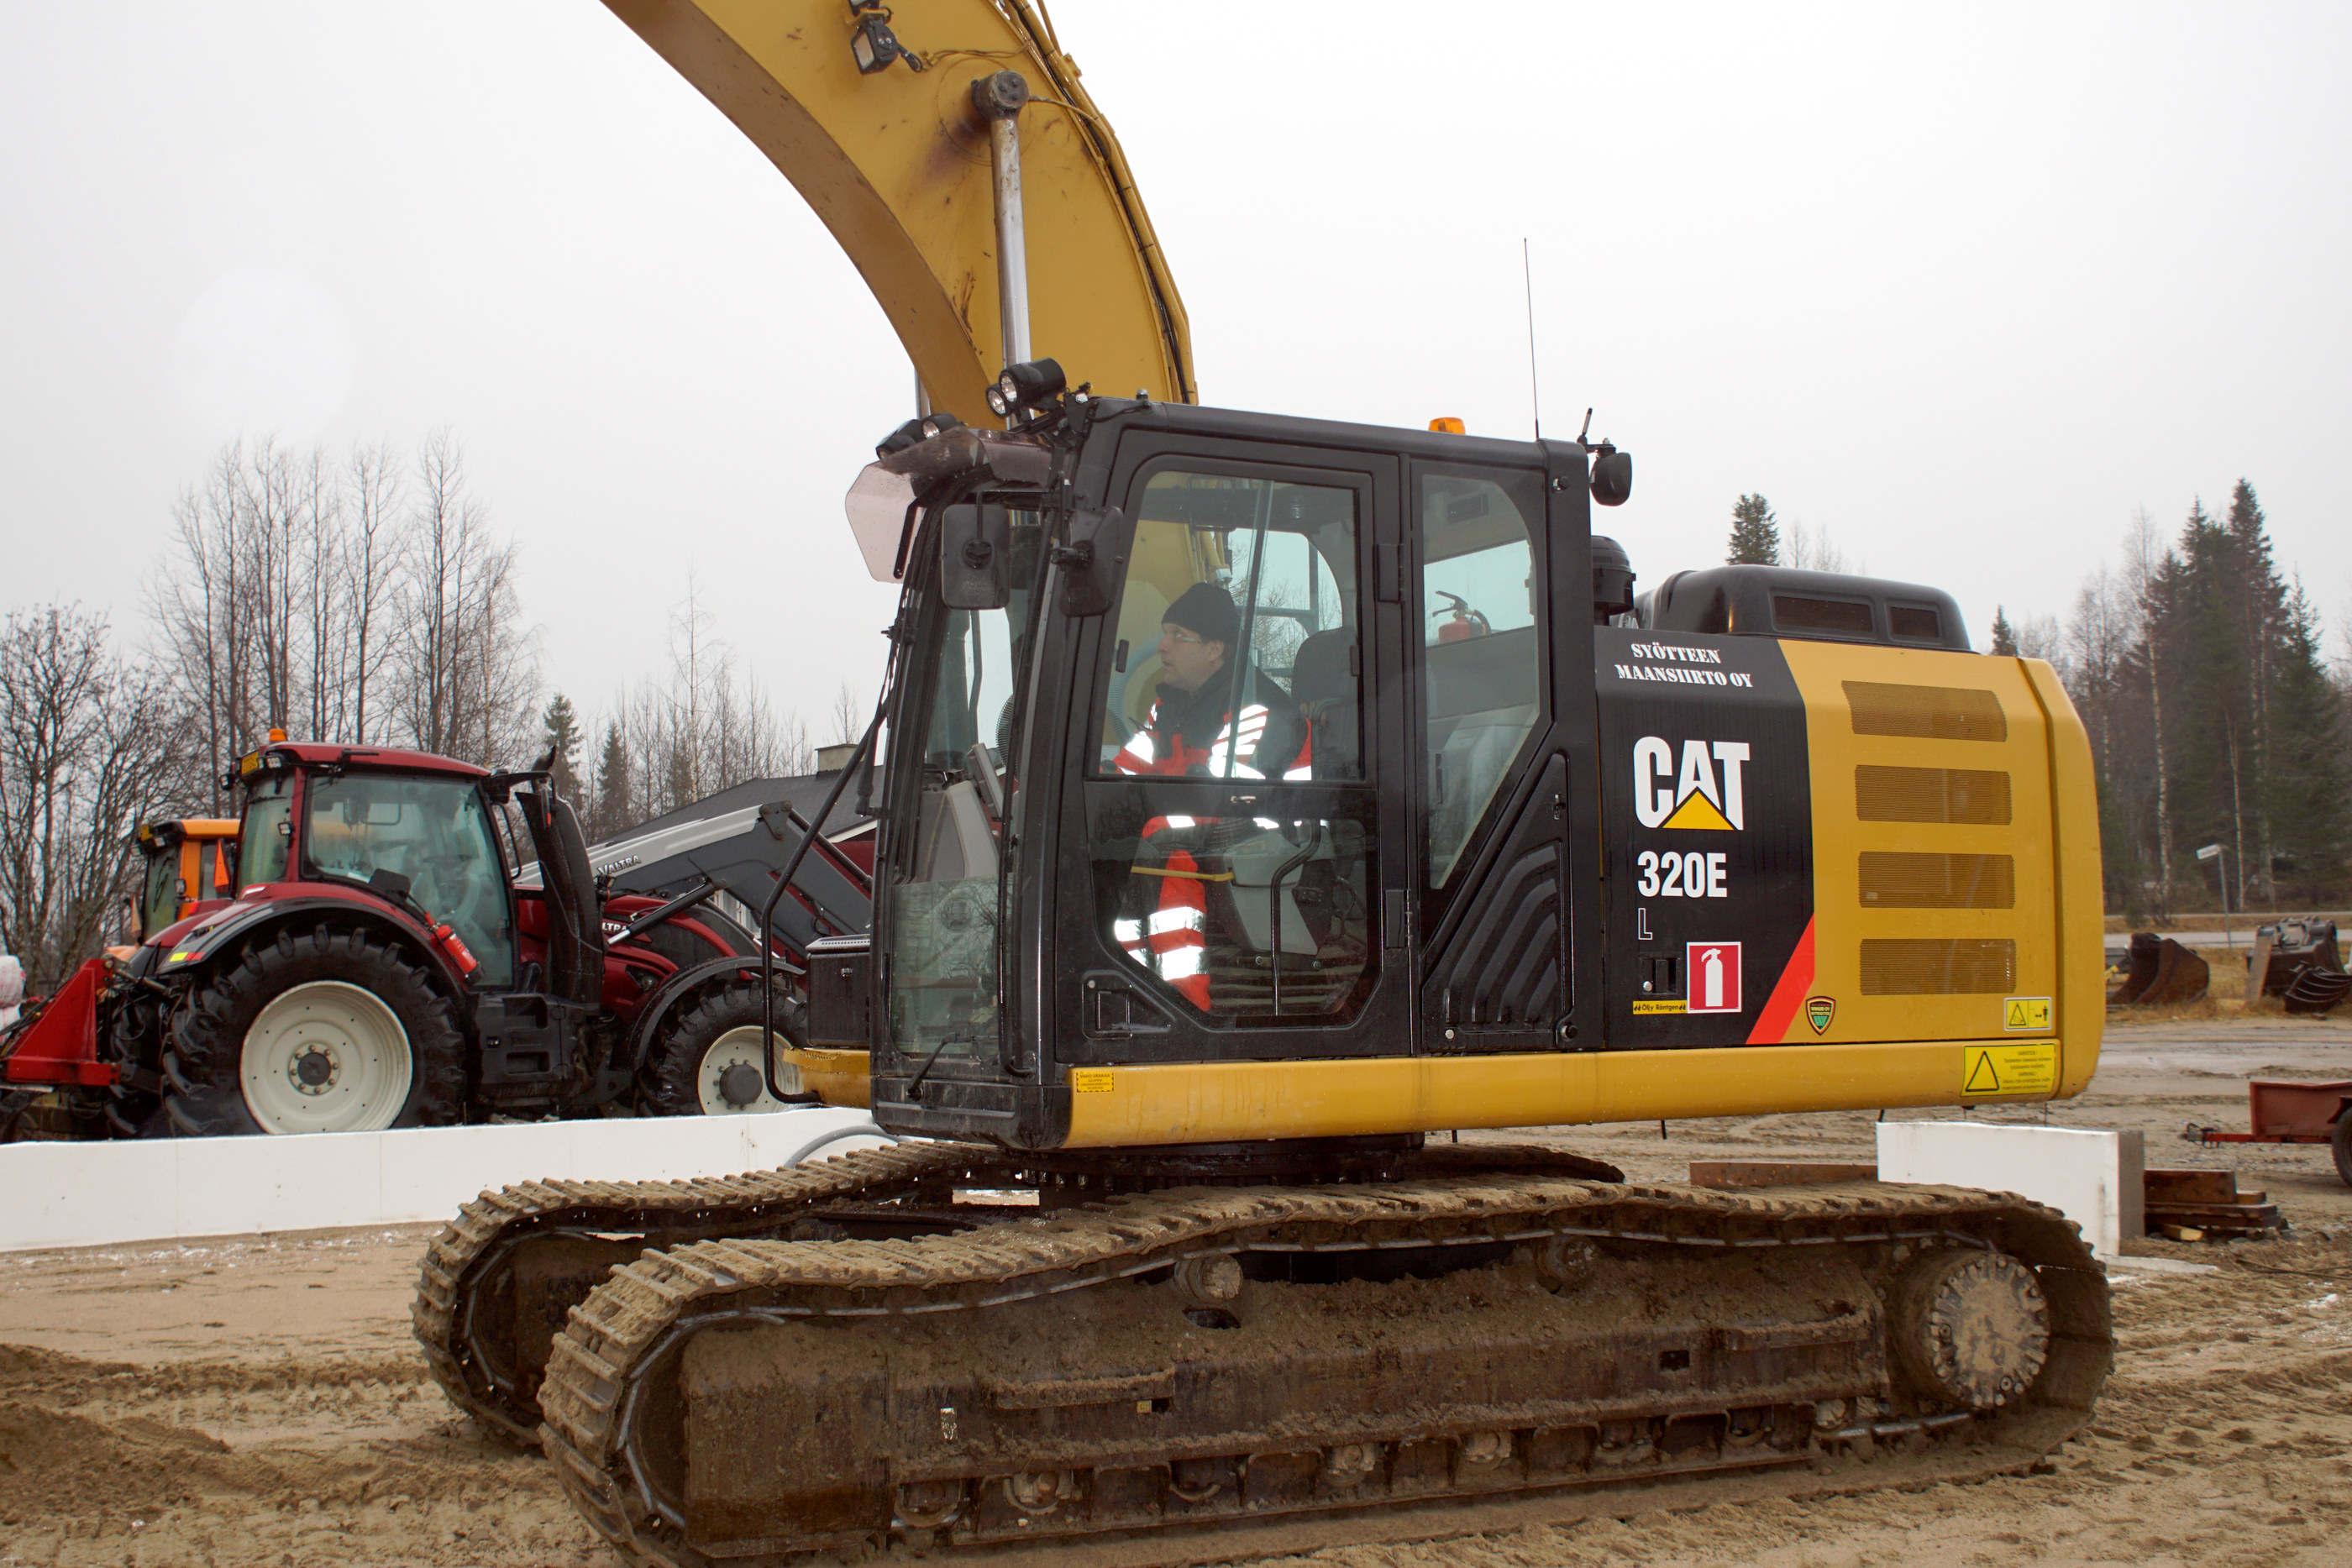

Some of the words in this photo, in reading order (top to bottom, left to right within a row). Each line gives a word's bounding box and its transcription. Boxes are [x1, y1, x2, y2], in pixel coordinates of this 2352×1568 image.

[1630, 642, 1721, 663] SYÖTTEEN
[1614, 664, 1728, 686] MAANSIIRTO
[1729, 672, 1753, 688] OY
[1634, 736, 1751, 831] CAT
[597, 855, 642, 875] VALTRA
[1638, 851, 1727, 898] 320E
[601, 922, 627, 931] LTRA
[1638, 908, 1653, 940] L
